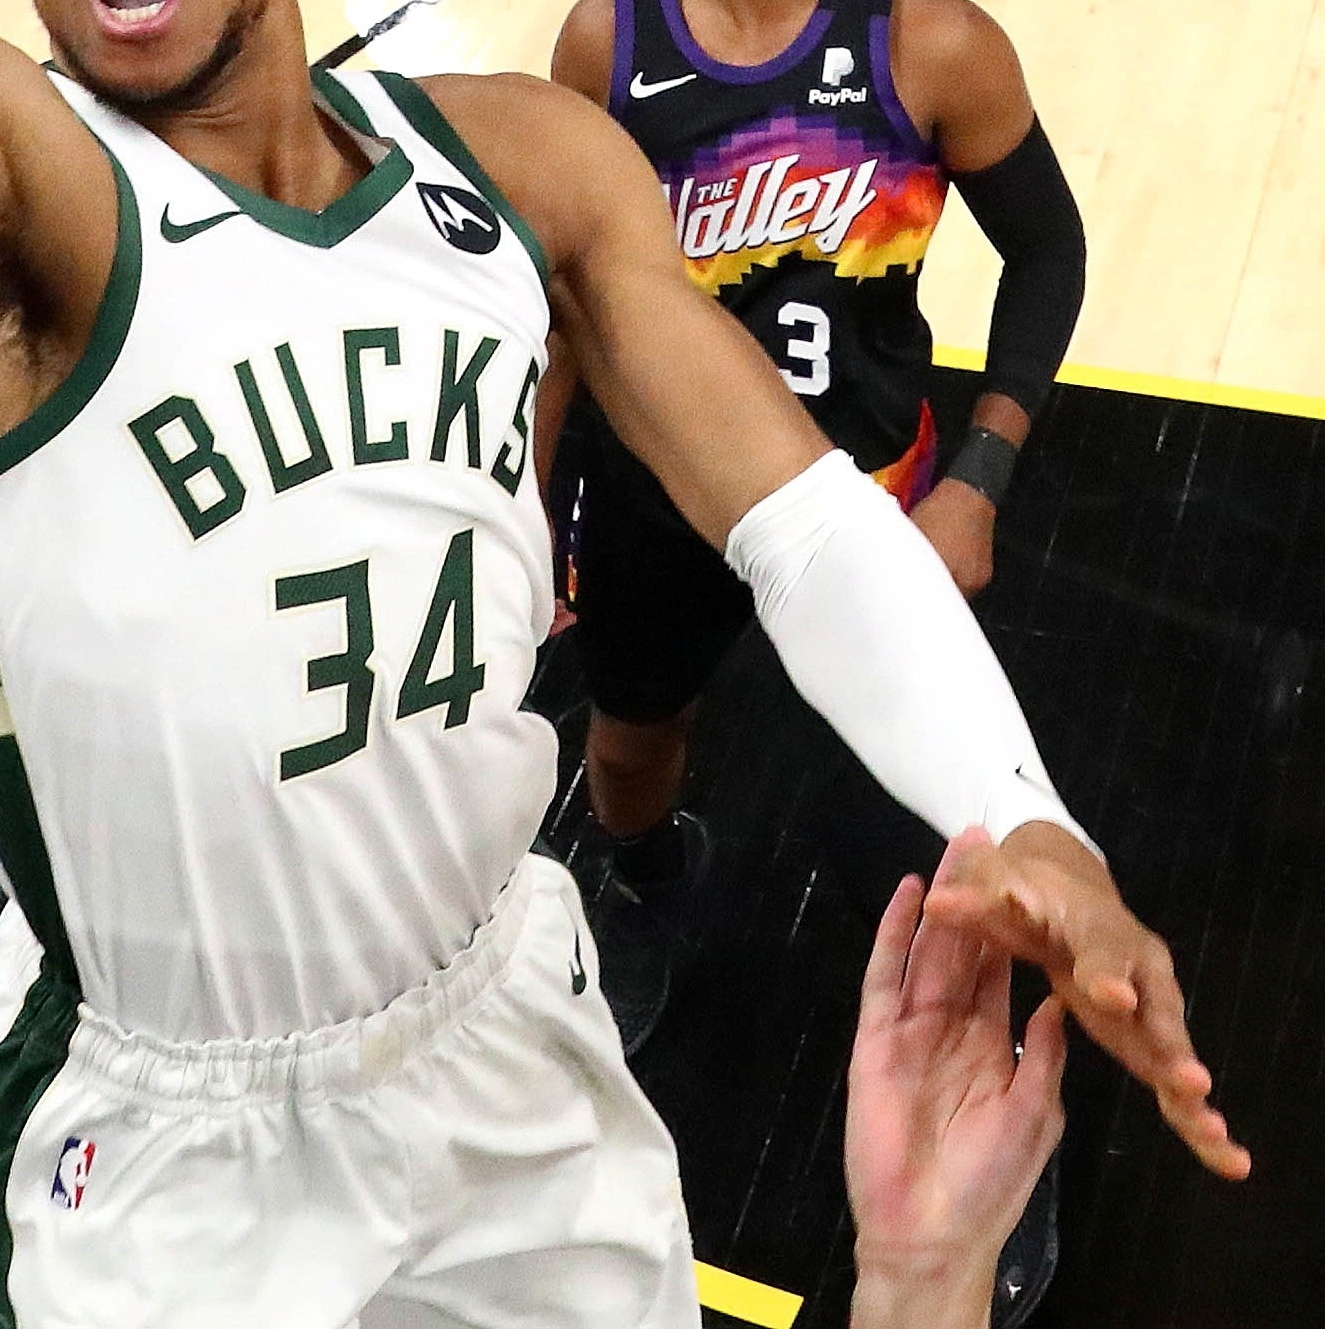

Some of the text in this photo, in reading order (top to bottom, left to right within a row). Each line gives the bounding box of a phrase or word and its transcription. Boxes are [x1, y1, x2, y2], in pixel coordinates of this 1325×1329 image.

[808, 87, 867, 106] PayPal
[697, 178, 739, 203] THE
[777, 302, 830, 397] 3
[125, 325, 541, 541] BUCKS
[274, 527, 485, 783] 34
